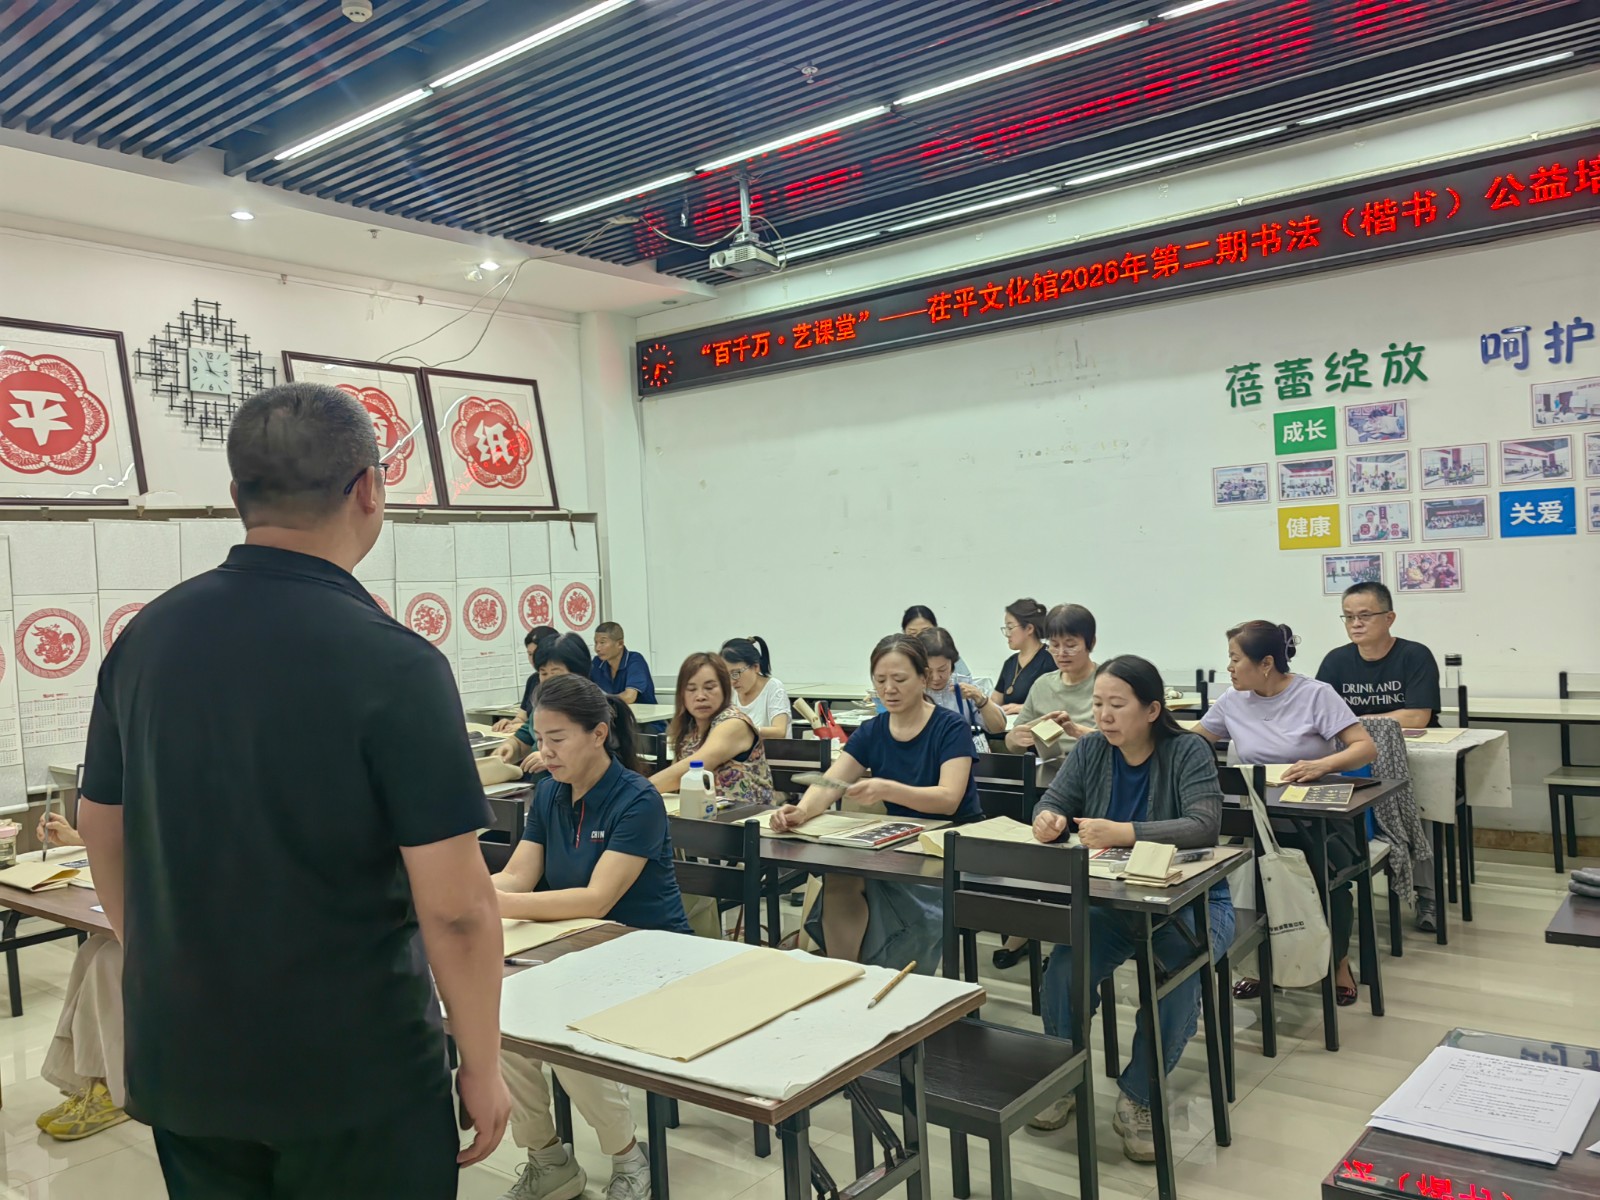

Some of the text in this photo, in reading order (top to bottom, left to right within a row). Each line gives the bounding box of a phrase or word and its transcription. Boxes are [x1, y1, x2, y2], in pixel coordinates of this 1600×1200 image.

[1480, 316, 1595, 371] 呵护
[1225, 341, 1429, 408] 蓓蕾绽放
[7, 389, 74, 447] 平
[1281, 418, 1328, 445] 成长
[473, 419, 514, 466] 纸
[1286, 515, 1332, 540] 健康
[1509, 500, 1564, 526] 关爱
[1375, 680, 1402, 693] AND
